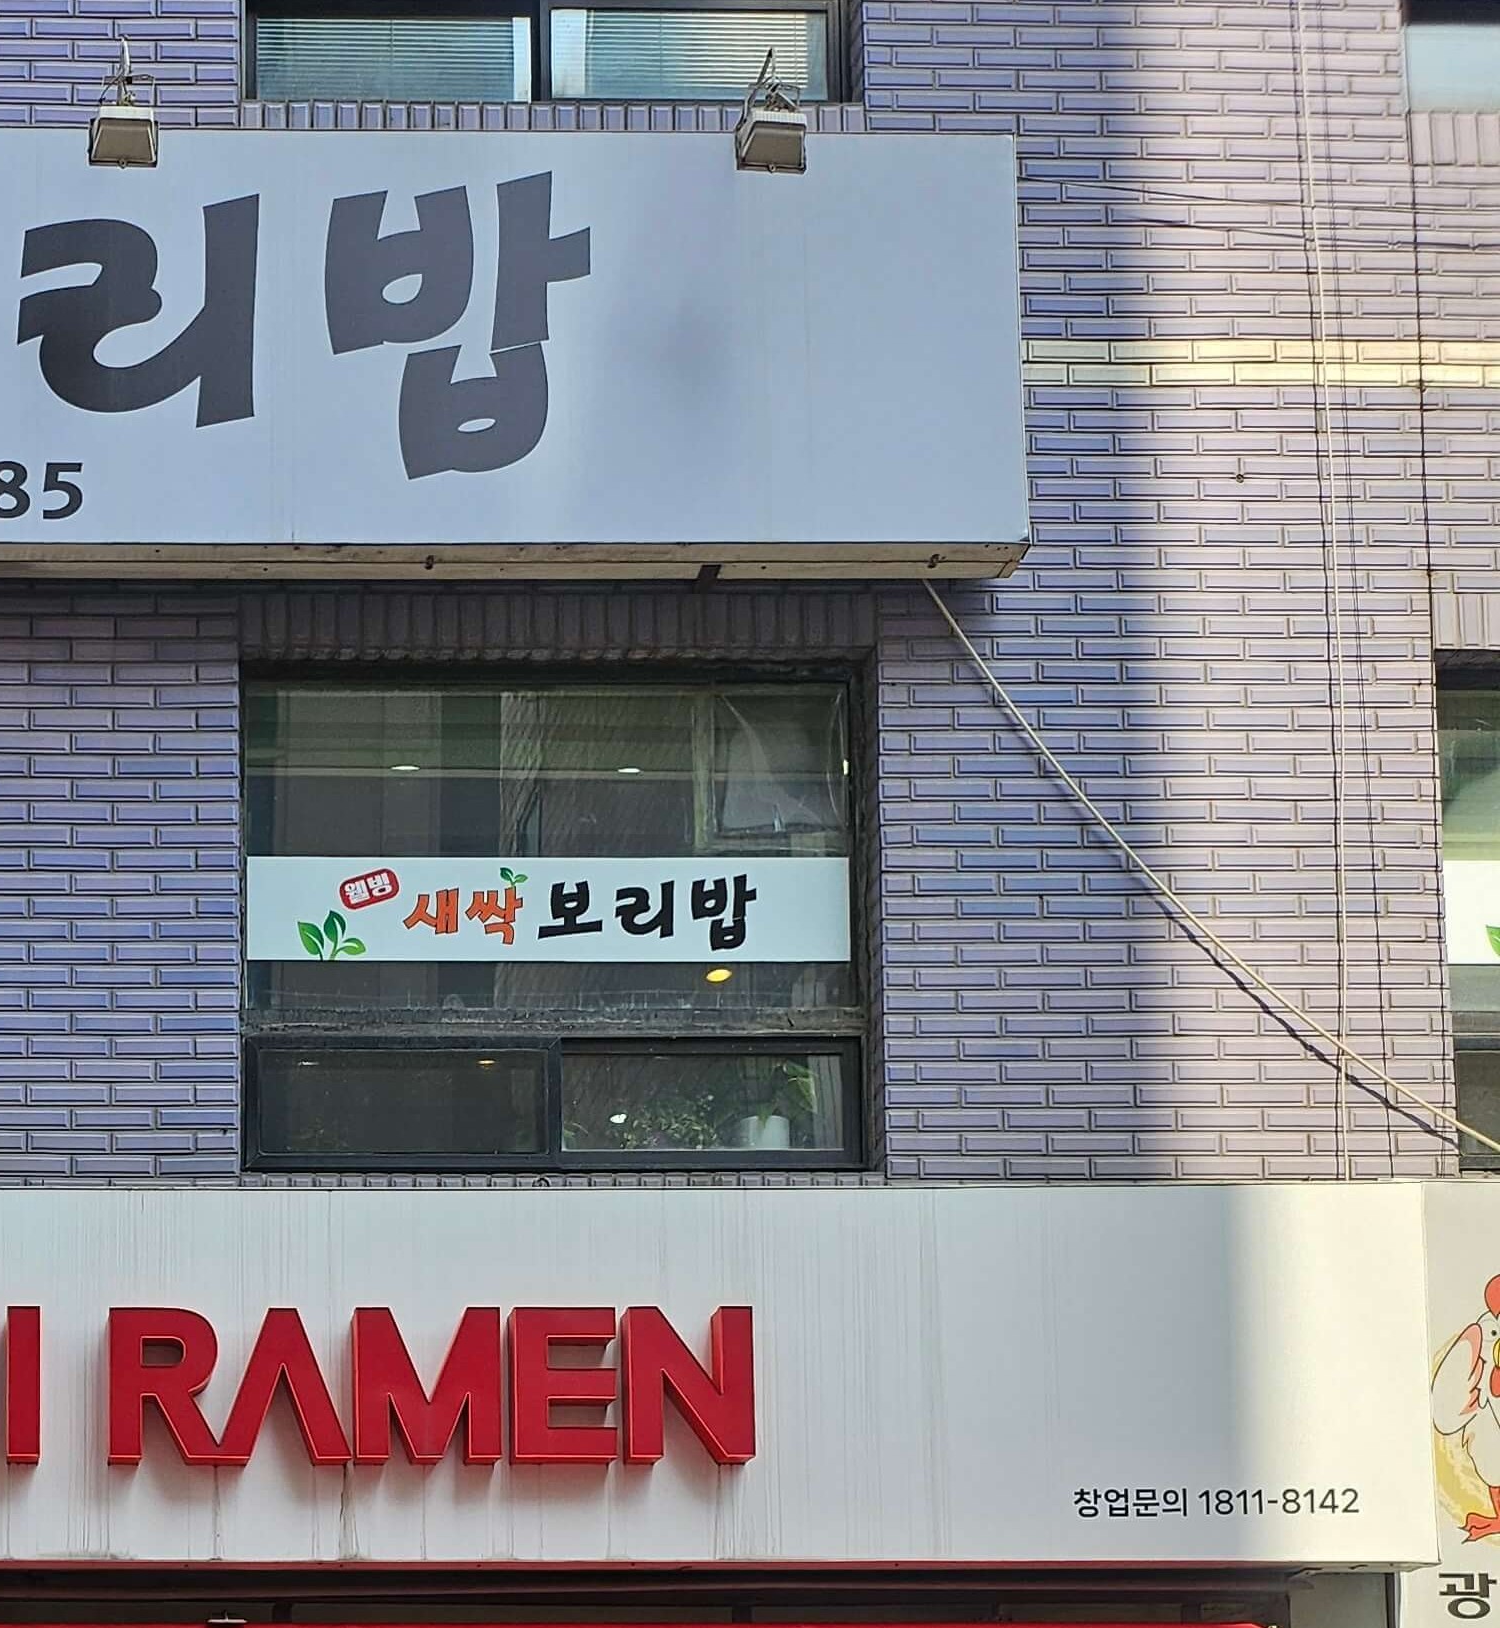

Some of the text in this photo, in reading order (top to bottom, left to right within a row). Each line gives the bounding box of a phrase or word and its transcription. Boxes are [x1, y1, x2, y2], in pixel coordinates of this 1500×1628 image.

[344, 873, 393, 905] 웰빙
[402, 873, 758, 952] 새싹 보리밥
[107, 1305, 757, 1467] RAMEN
[1072, 1487, 1361, 1519] 창업문의 1811-8142
